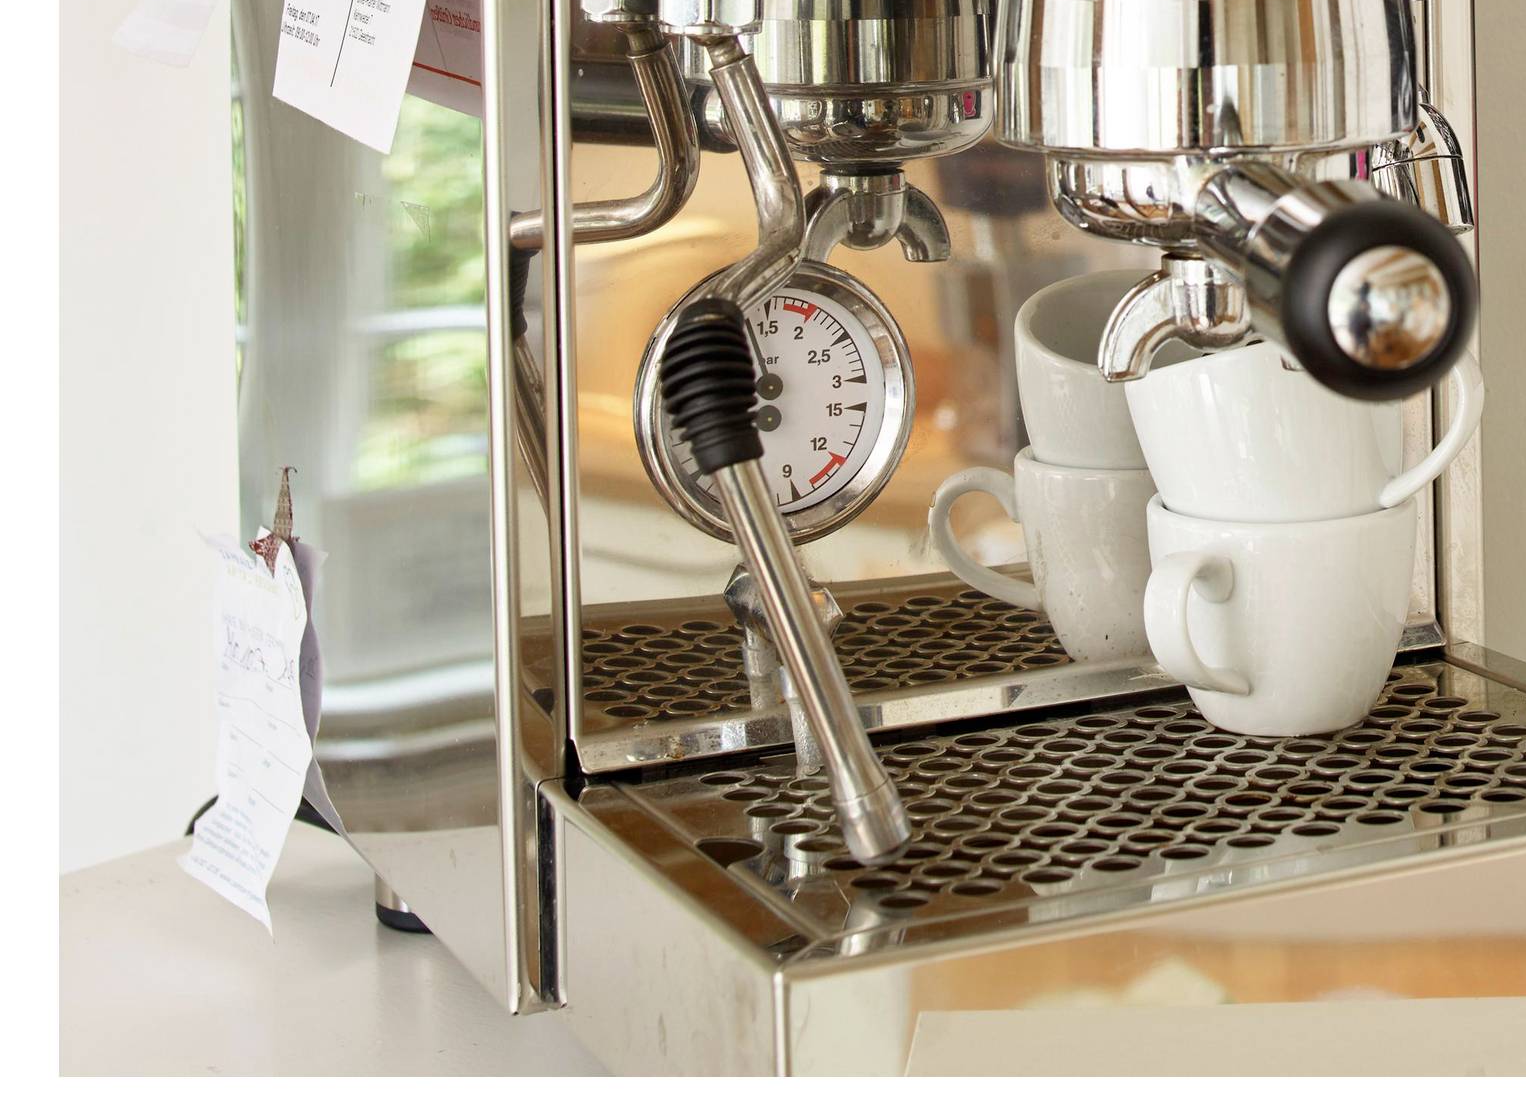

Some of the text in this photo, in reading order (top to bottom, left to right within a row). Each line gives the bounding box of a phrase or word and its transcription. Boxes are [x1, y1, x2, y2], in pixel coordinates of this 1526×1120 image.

[757, 320, 779, 337] 1,5
[793, 326, 804, 340] 2
[807, 349, 831, 365] 2,5
[832, 375, 842, 389] 3
[826, 403, 843, 417] 15
[810, 437, 828, 451] 12
[782, 464, 792, 478] 9
